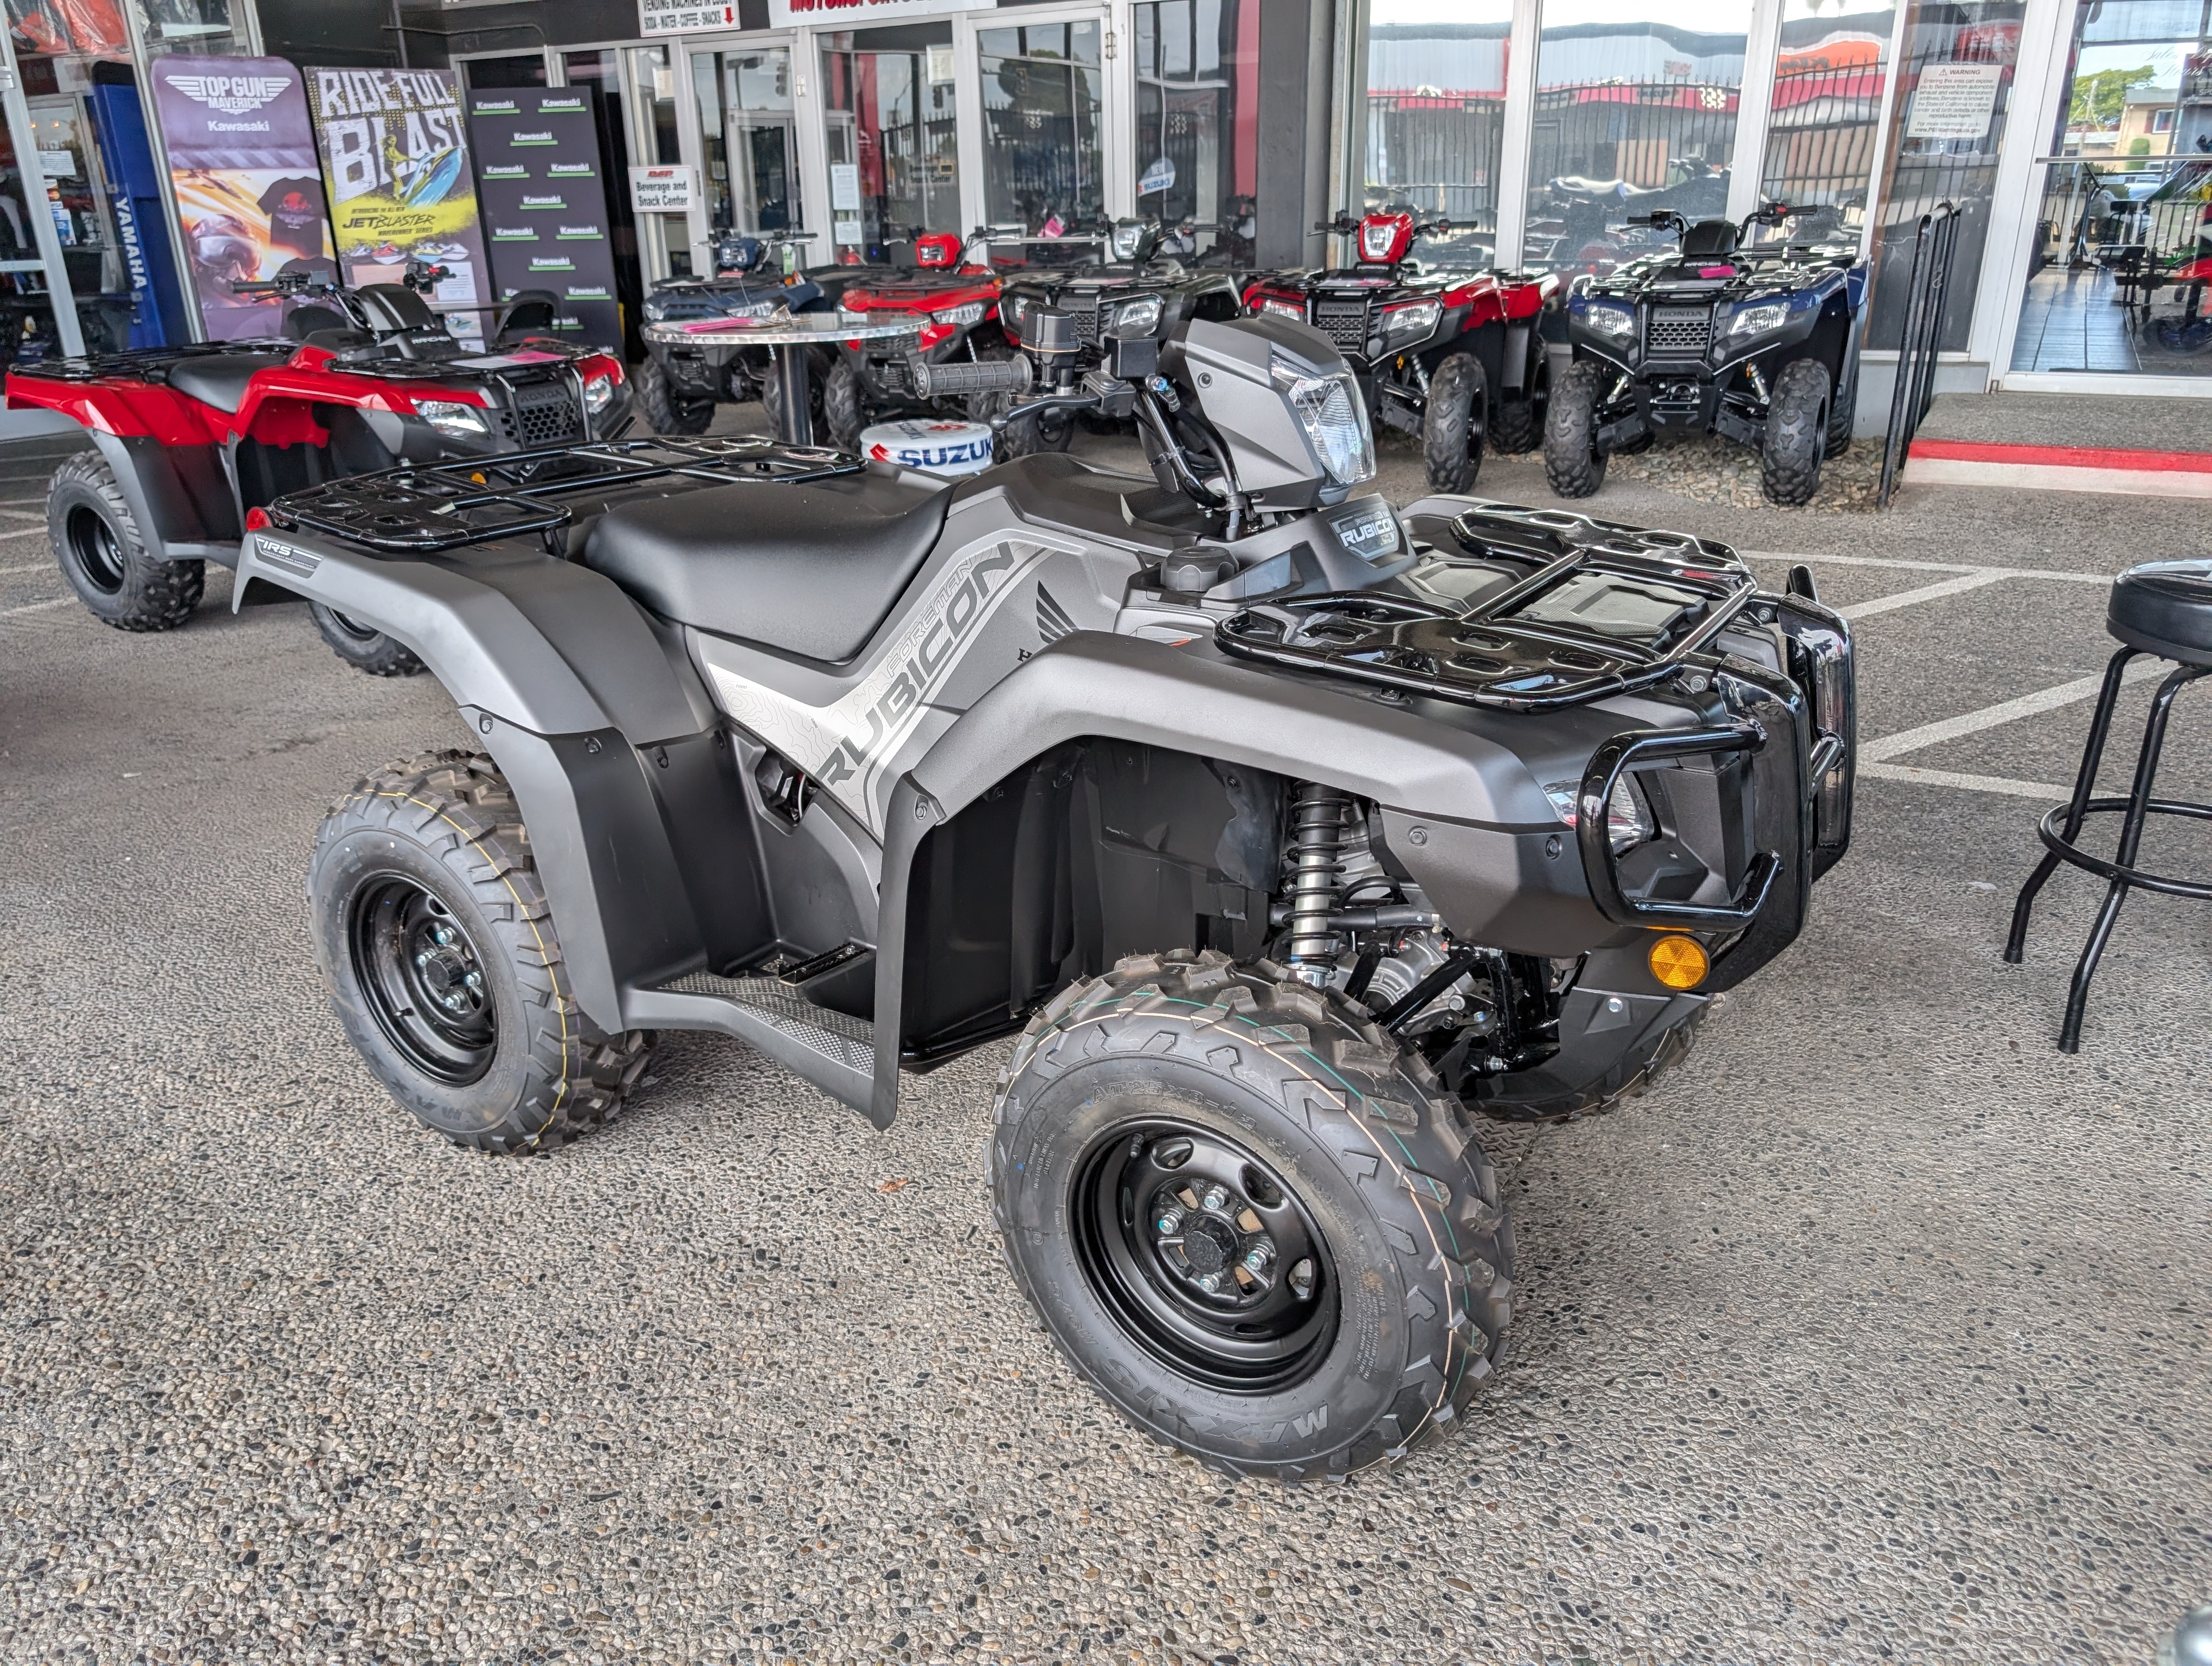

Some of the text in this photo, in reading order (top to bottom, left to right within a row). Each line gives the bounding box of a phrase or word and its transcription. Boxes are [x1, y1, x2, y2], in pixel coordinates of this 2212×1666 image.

[702, 10, 722, 25] SNACKS
[200, 76, 267, 97] TOP GUN
[317, 71, 456, 118] RIDE FULL
[208, 97, 262, 109] MAVERICK
[475, 98, 581, 110] Kawasaki Kawasaki
[207, 120, 270, 132] Kawasaki
[513, 131, 552, 141] Kawasaki
[325, 107, 467, 206] BLAST
[486, 162, 590, 174] Kawasaki Kawasaki
[636, 181, 687, 194] Beverage and
[523, 194, 562, 204] Kawasaki
[638, 195, 687, 207] Snack Center
[343, 214, 436, 229] JETBLASTER
[495, 225, 598, 236] Kawasaki Kawasaki
[115, 197, 147, 289] YAMAHA
[532, 256, 570, 266] Kawasaki
[568, 285, 606, 296] Kawasaki
[898, 437, 993, 467] SUZUK
[1340, 517, 1396, 547] RUBICON
[263, 541, 292, 556] IRS
[887, 556, 974, 678] FOREMAN
[815, 541, 1015, 786] RUBICON
[1101, 1357, 1329, 1444] MAXXIS
